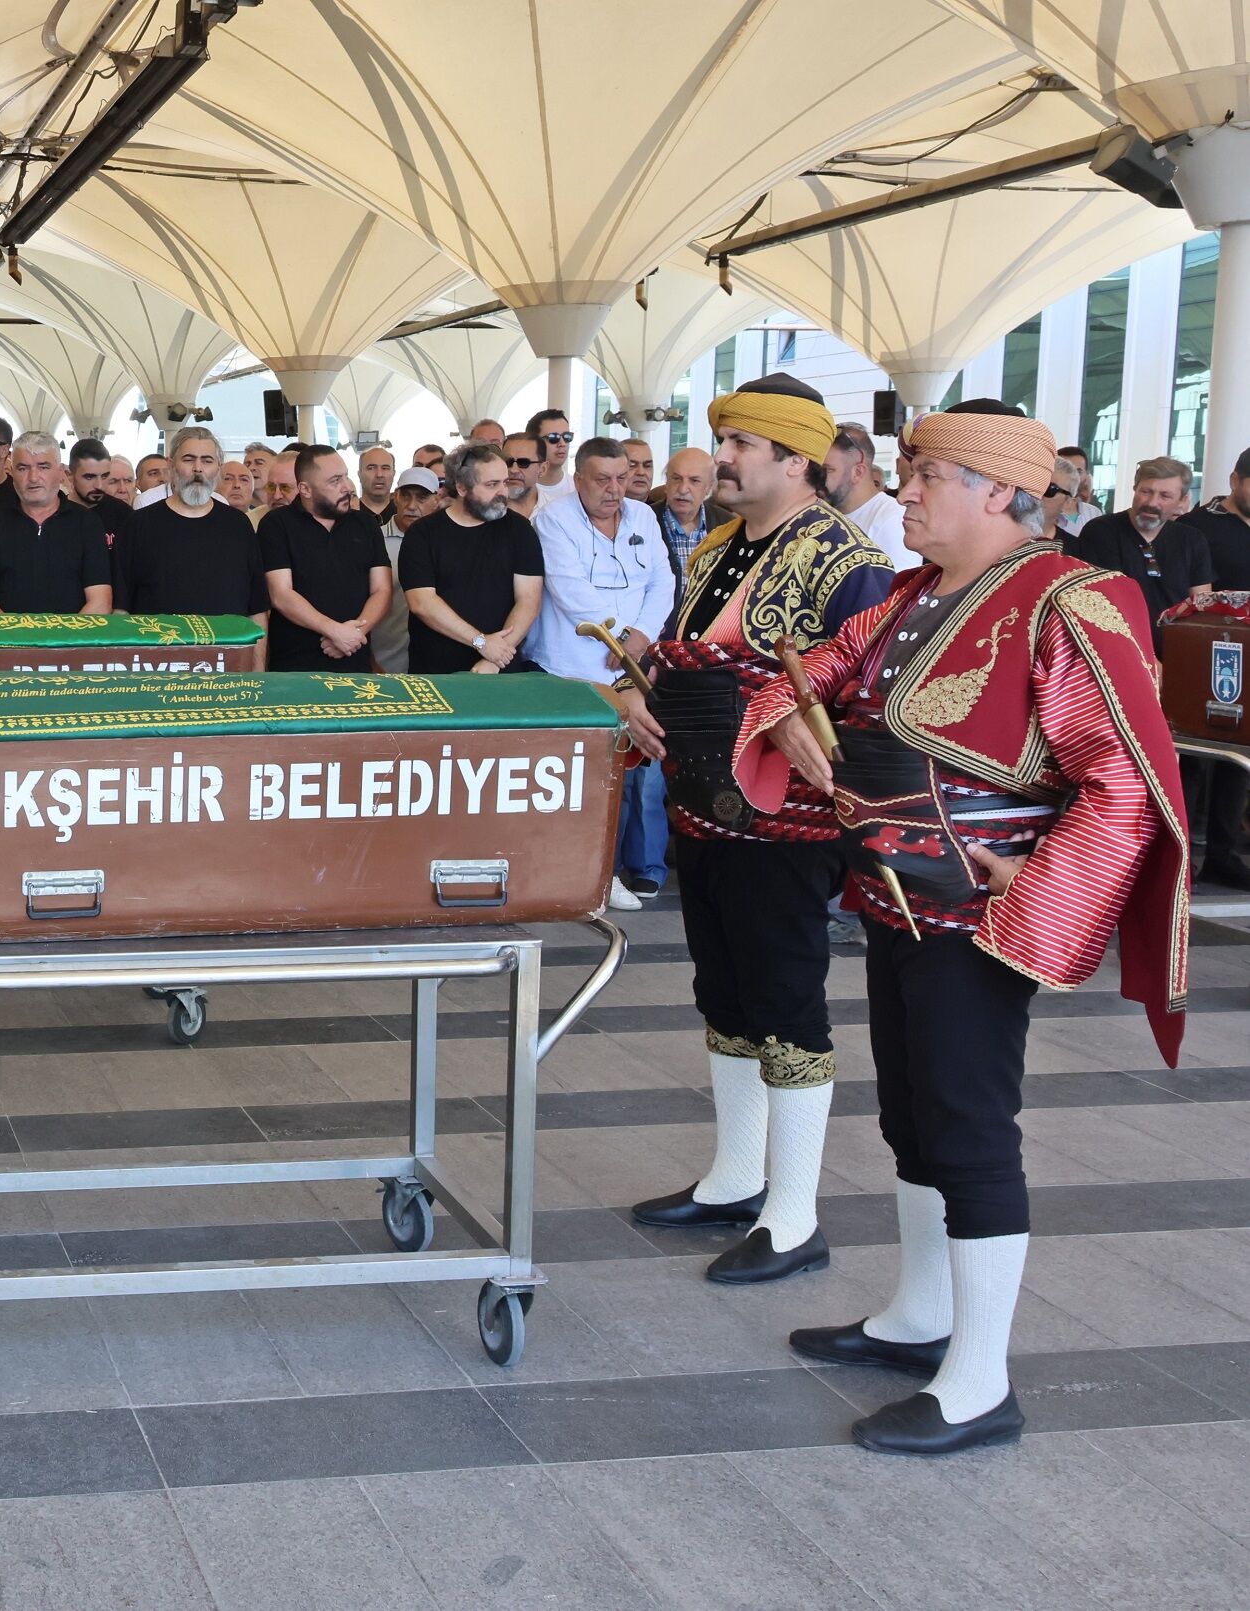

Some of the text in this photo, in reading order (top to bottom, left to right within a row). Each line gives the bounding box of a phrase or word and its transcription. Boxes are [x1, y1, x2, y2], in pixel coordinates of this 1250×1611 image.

[11, 688, 48, 698] ölümü
[140, 683, 162, 693] bize
[170, 694, 213, 703] Ankebut
[215, 693, 238, 704] Ayet
[240, 690, 252, 701] 57
[248, 741, 585, 821] BELEDİYESİ
